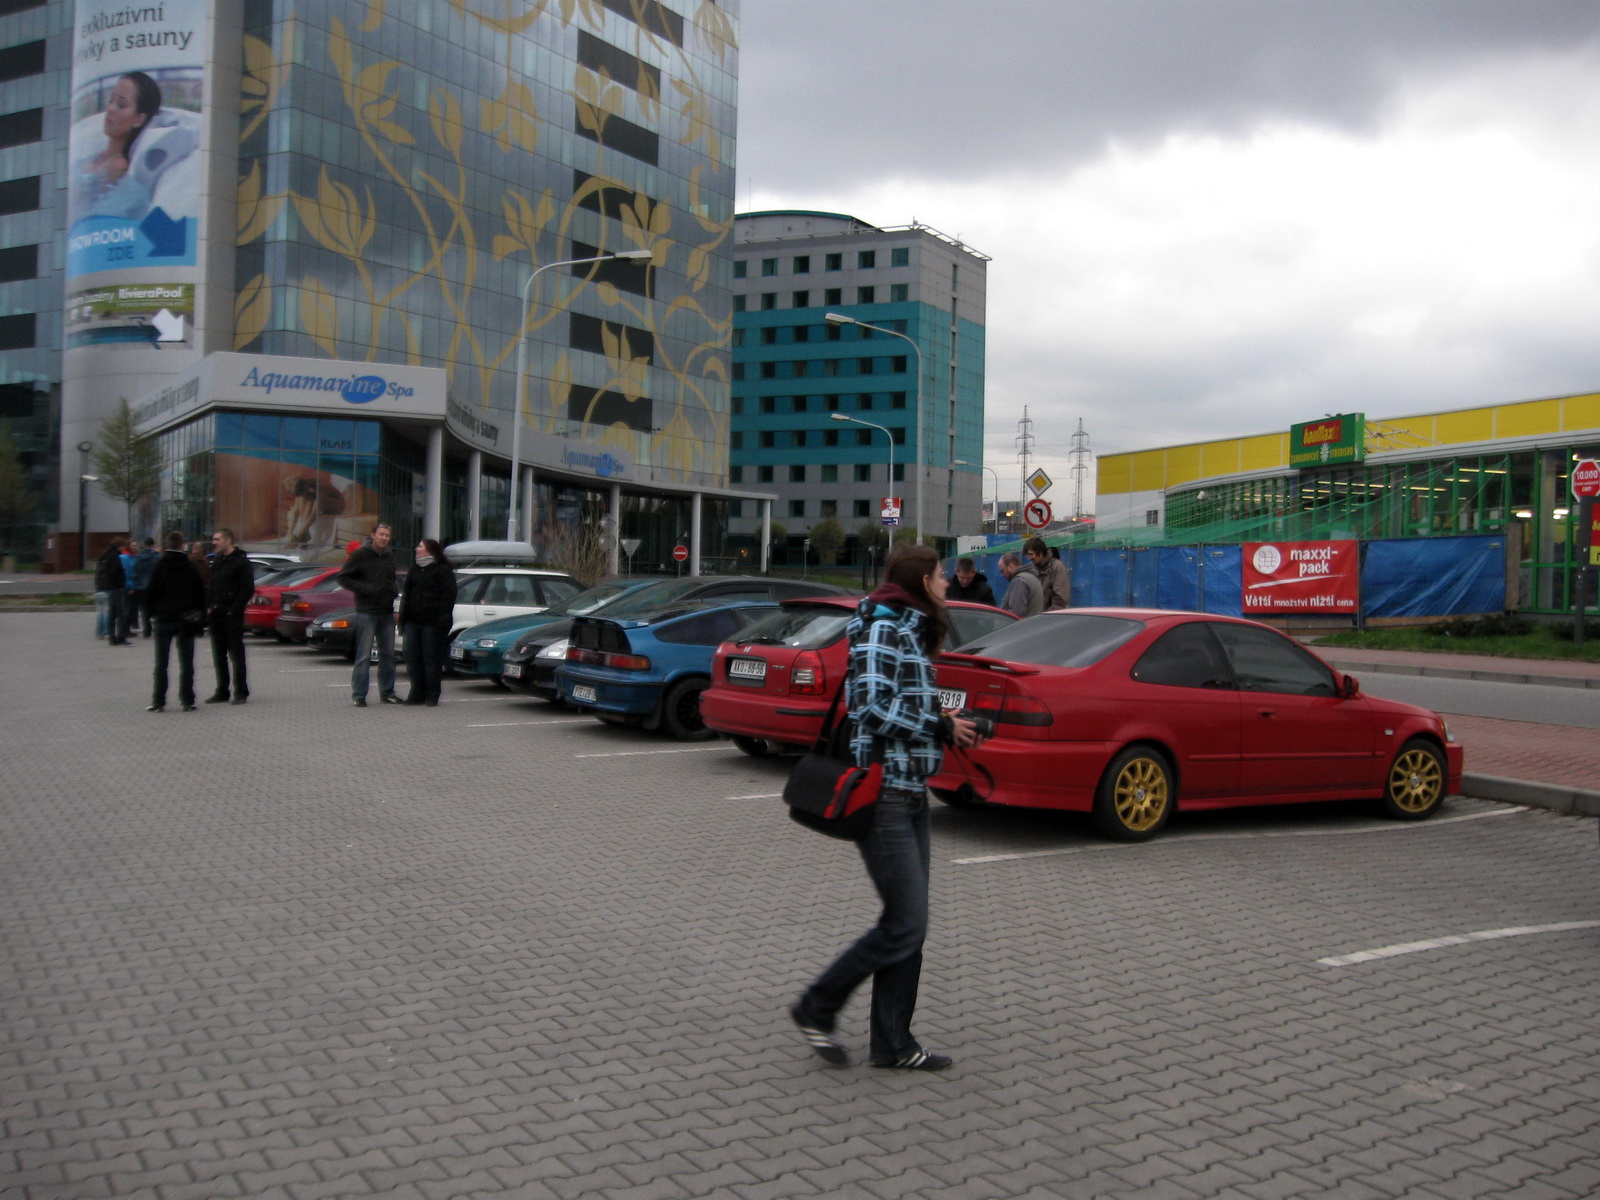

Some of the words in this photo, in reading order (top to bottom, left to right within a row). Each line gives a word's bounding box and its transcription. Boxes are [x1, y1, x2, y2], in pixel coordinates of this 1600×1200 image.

[110, 38, 120, 52] a
[126, 31, 193, 50] sauny
[107, 245, 134, 261] ZDE
[118, 286, 183, 300] RivieraPool
[240, 366, 381, 395] Aquamarine
[386, 381, 414, 400] Spa
[320, 440, 352, 449] KLAFS
[1290, 546, 1338, 560] maxxi-
[1299, 560, 1329, 577] pack
[1245, 594, 1271, 607] Větší
[1310, 595, 1334, 607] nižší
[1336, 599, 1354, 607] cena
